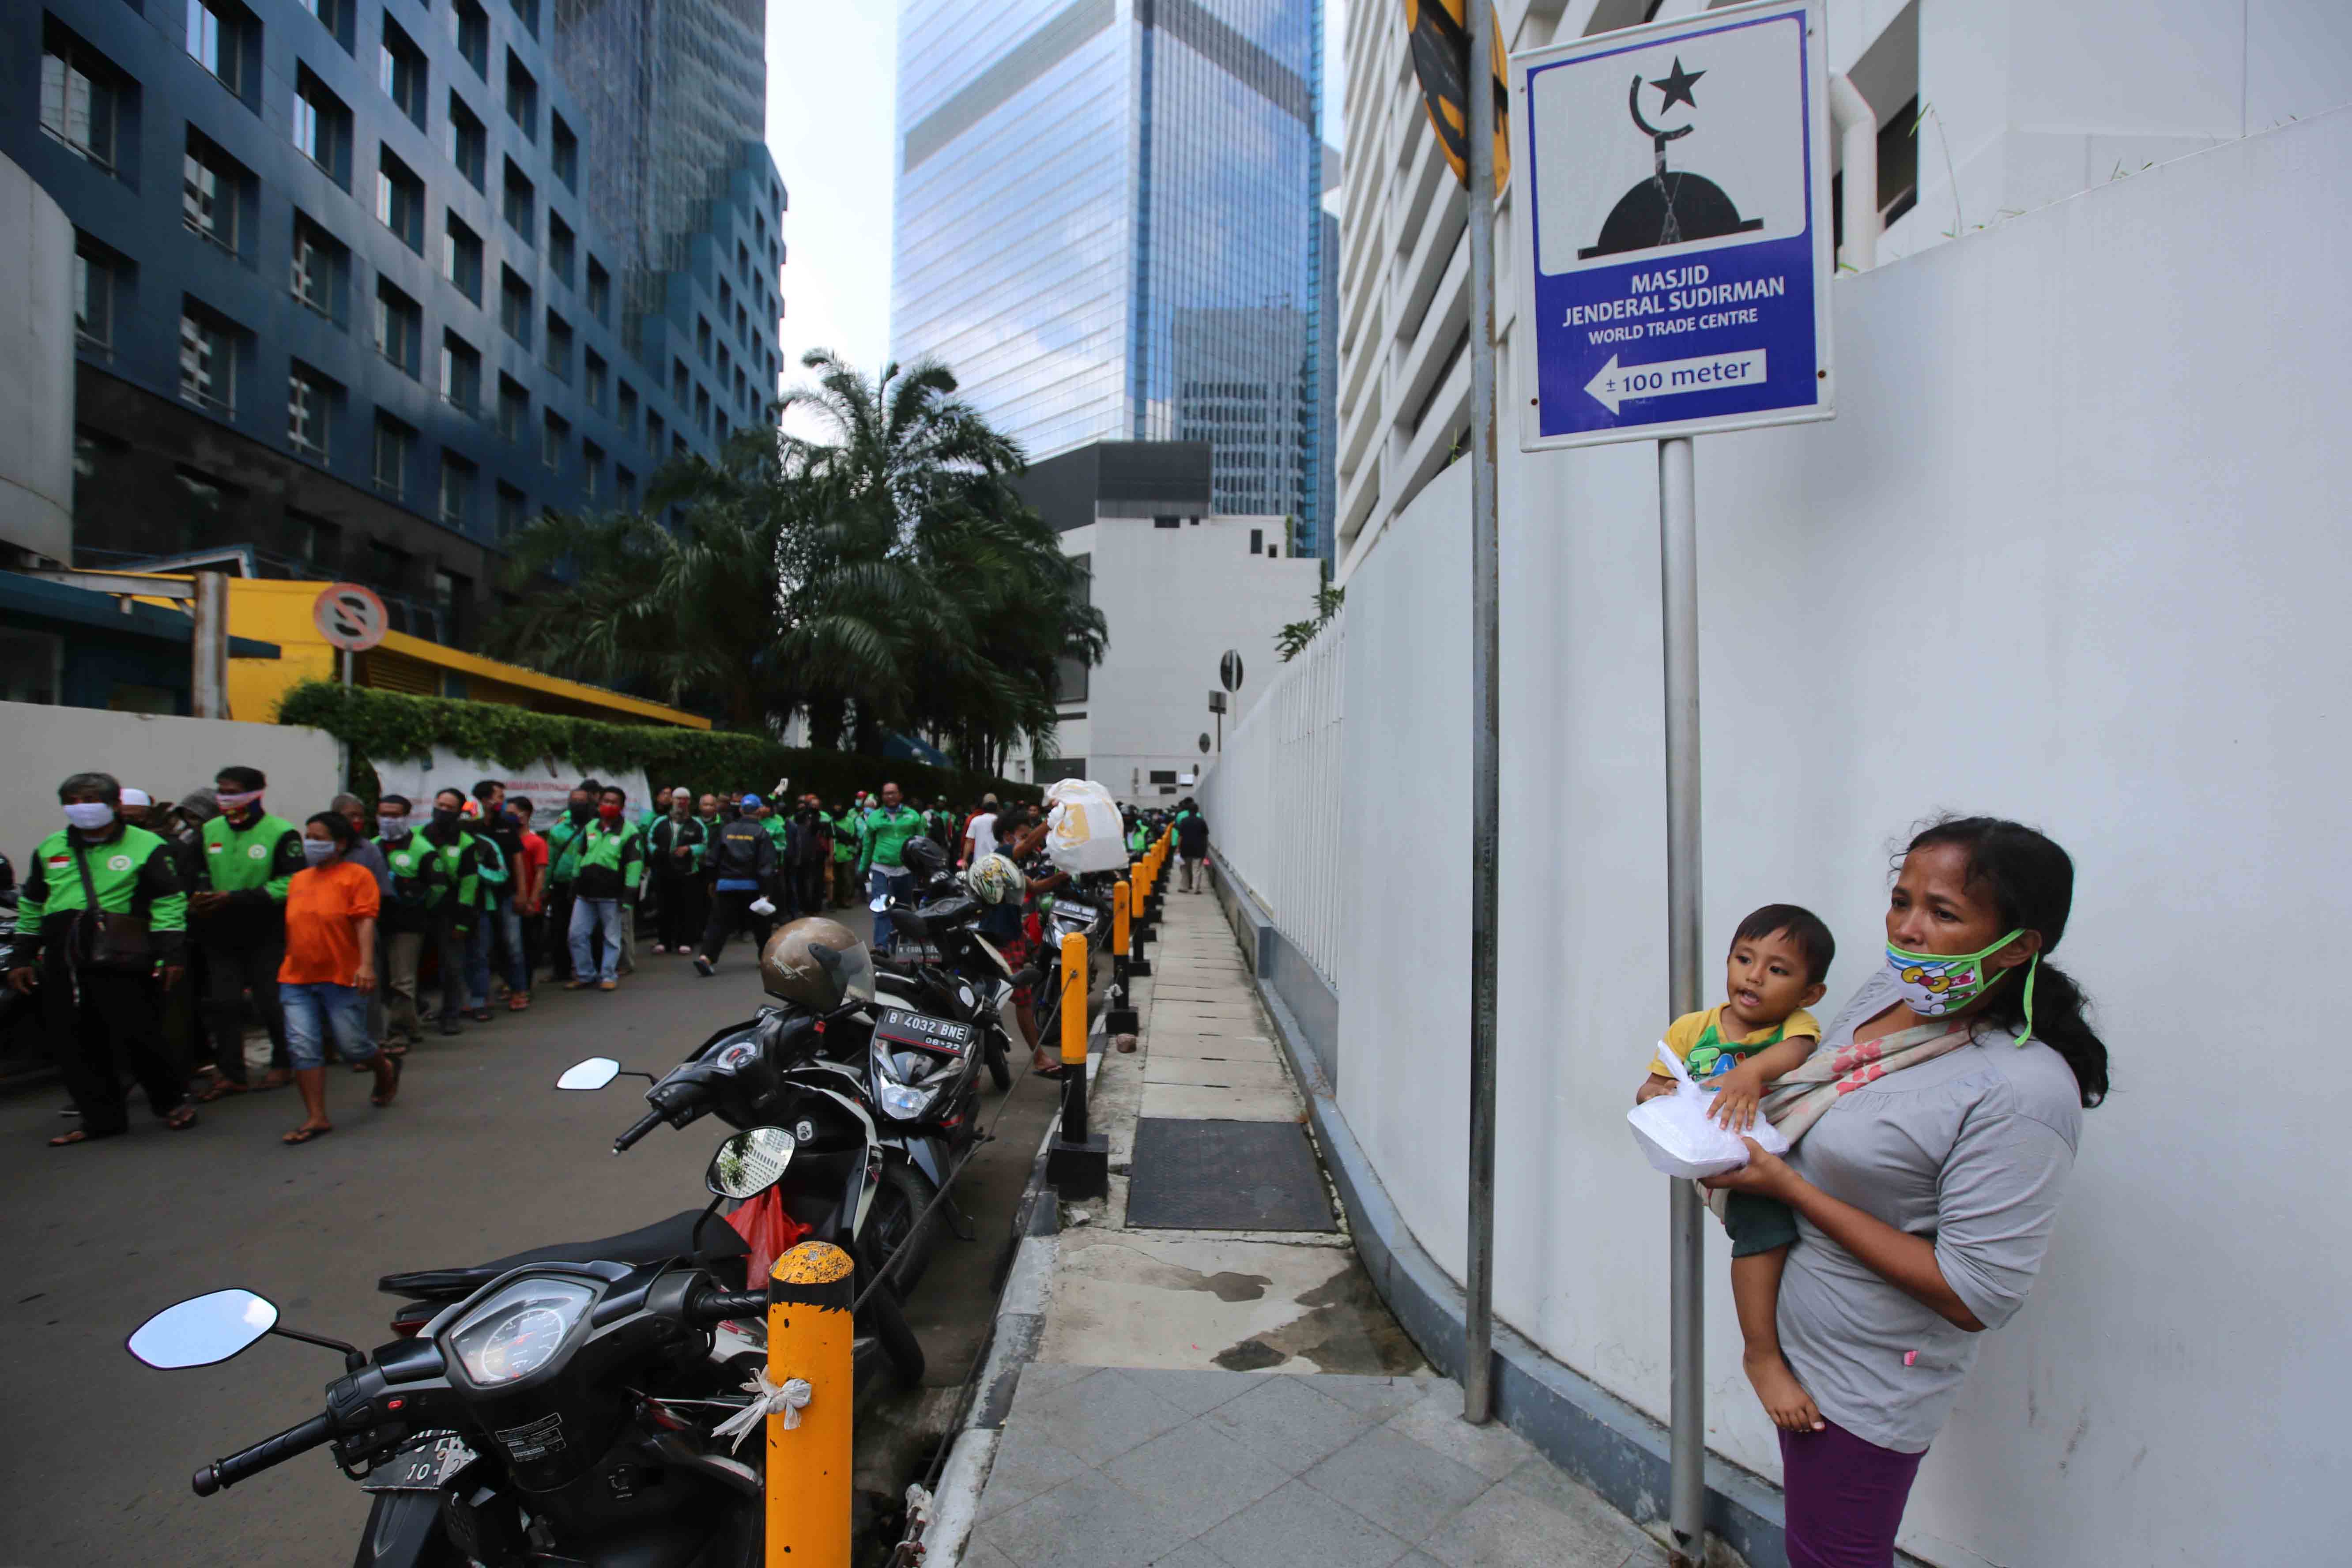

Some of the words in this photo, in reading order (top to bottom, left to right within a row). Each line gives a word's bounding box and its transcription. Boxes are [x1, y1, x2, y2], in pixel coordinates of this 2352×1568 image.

[1631, 264, 1709, 294] MASJID
[1562, 294, 1665, 327] JENDERAL
[1669, 275, 1784, 311] SUDIRMAN
[1588, 324, 1643, 345] WORLD
[1646, 317, 1696, 337] TRADE
[1699, 308, 1758, 329] CENTRE
[1671, 361, 1751, 386] meter
[889, 1012, 898, 1024] B
[904, 1016, 936, 1034] 4032
[940, 1024, 965, 1040] BNE
